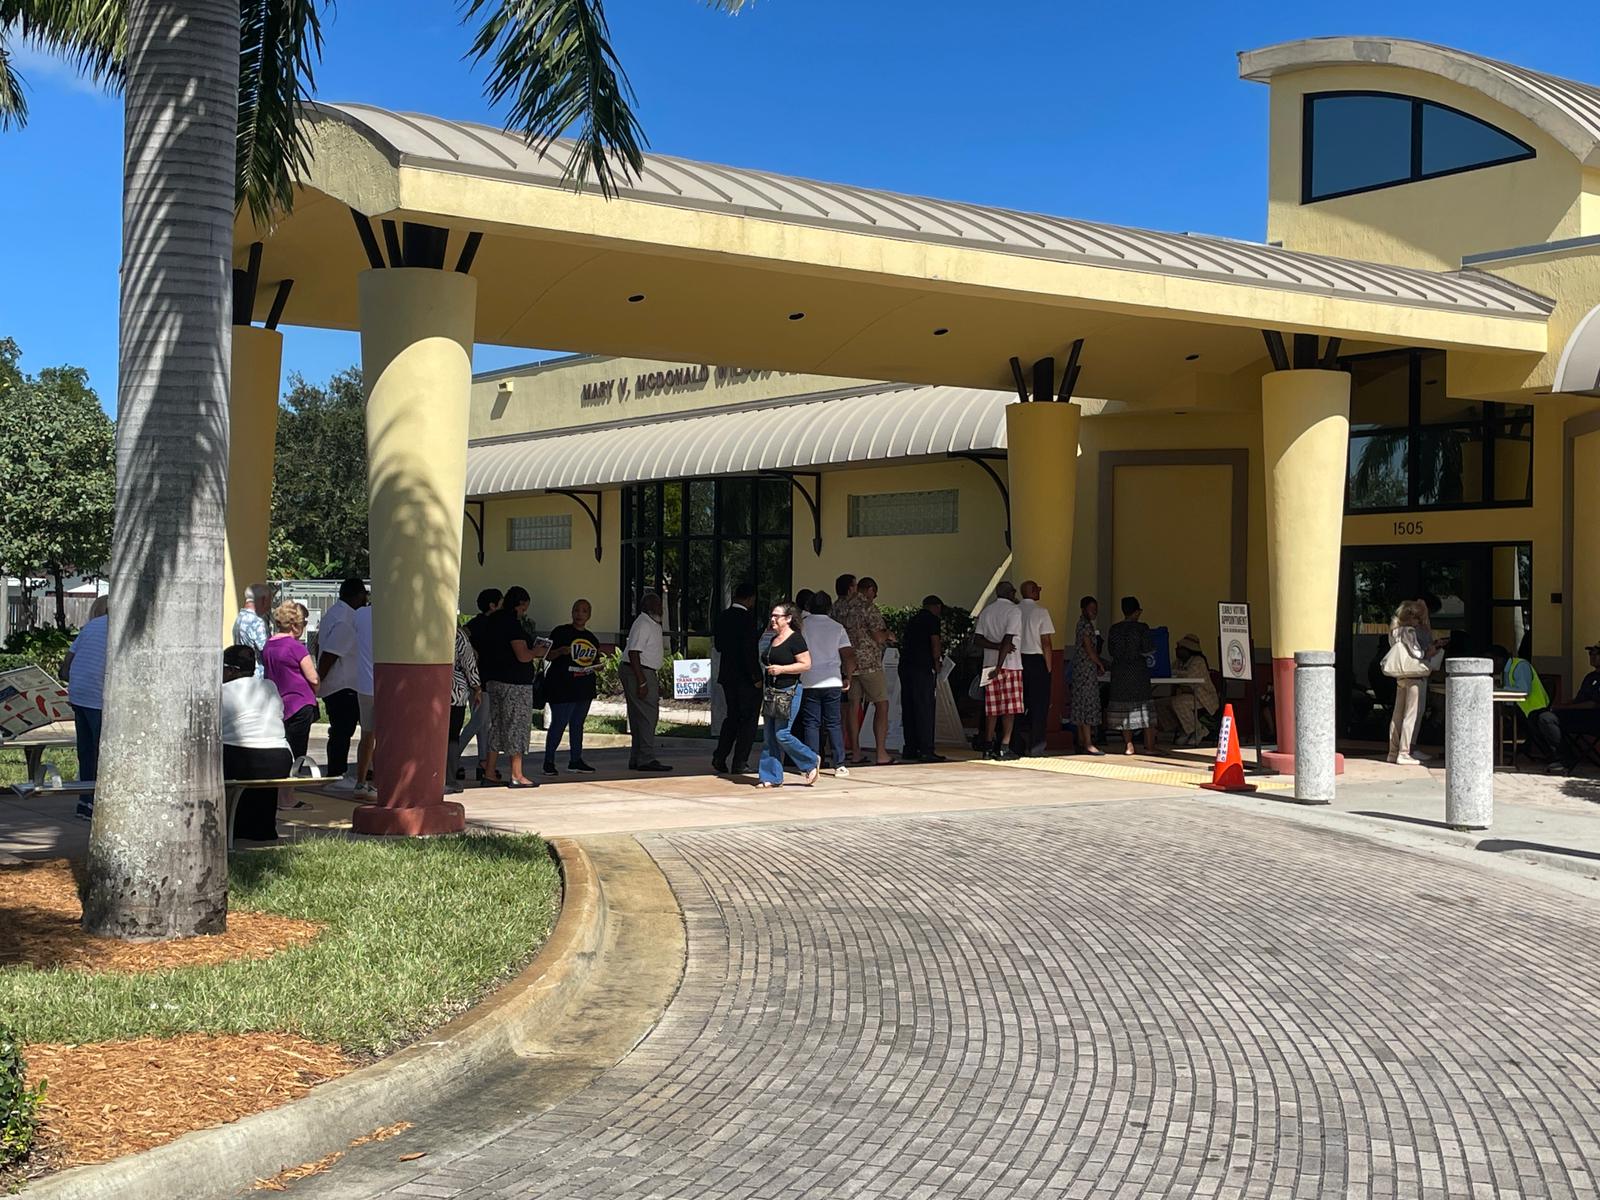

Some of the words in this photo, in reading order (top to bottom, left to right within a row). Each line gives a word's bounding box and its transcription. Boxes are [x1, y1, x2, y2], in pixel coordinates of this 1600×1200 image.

[582, 379, 615, 402] MARY
[637, 364, 709, 392] MCDONALD
[1394, 521, 1424, 536] 1505
